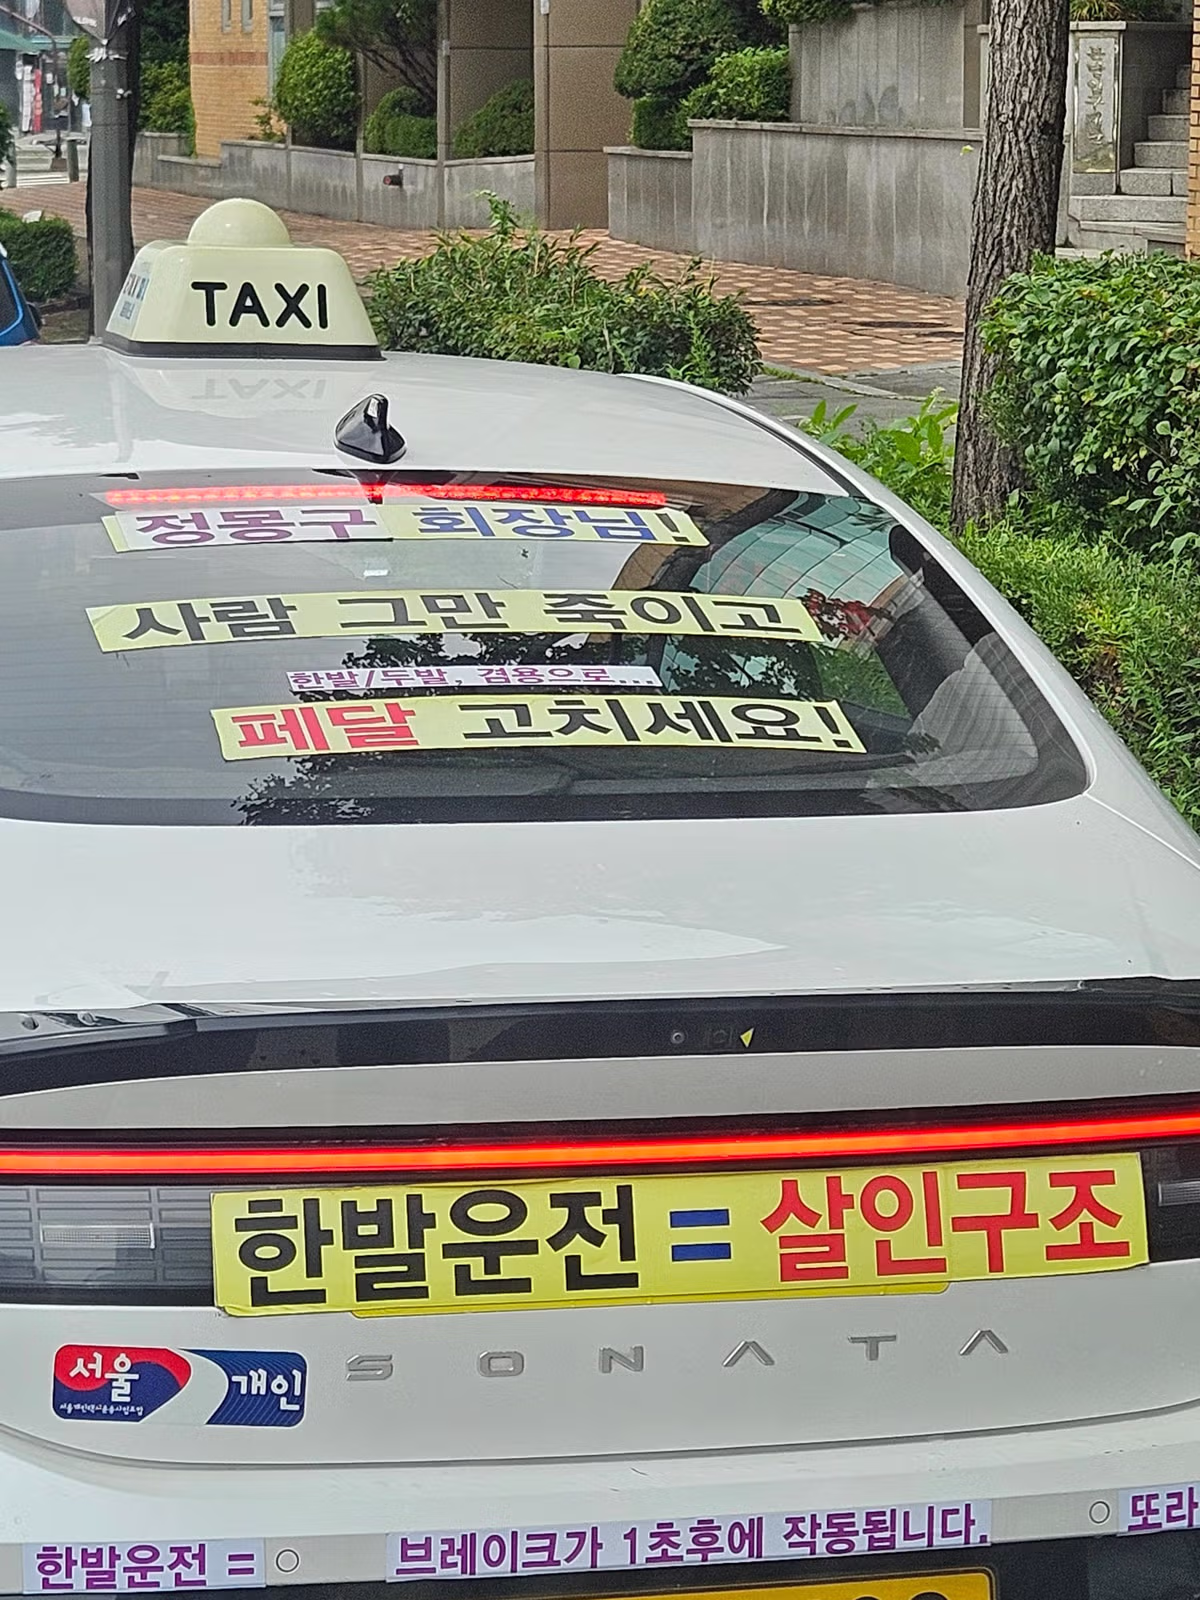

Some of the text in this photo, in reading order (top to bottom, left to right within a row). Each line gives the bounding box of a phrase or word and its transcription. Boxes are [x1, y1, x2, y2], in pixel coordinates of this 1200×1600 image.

[191, 282, 328, 329] TAXI
[136, 507, 690, 543] 정몽구 회장님!
[123, 591, 803, 641] 사람 그만 죽이고
[231, 698, 851, 751] 페달 고치세요!
[234, 1169, 1132, 1308] 한발운전 = 살인구조
[69, 1351, 140, 1403] 서울
[346, 1329, 1008, 1381] SONATA
[231, 1368, 305, 1412] 개인
[1127, 1486, 1199, 1532] 또라
[395, 1503, 988, 1575] 브레이크가 1초후에 작동됩니다.
[36, 1543, 255, 1590] 한발운전 =
